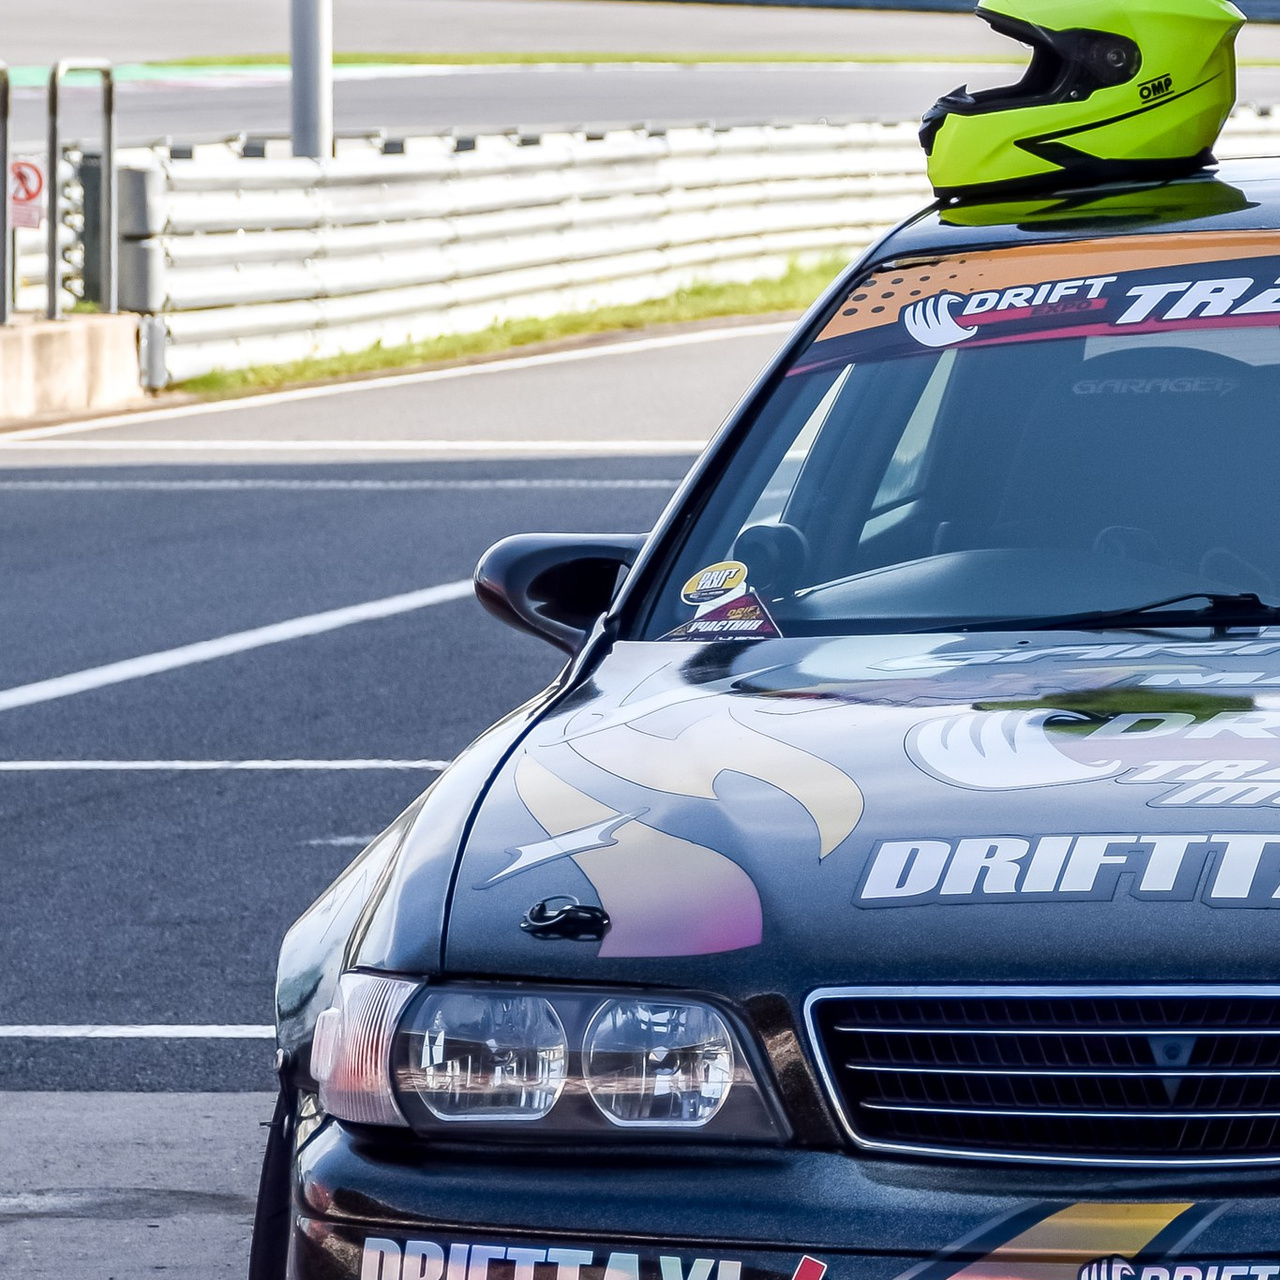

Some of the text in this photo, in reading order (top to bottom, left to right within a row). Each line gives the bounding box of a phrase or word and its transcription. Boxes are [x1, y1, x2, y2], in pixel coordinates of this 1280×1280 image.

[1139, 77, 1173, 99] OMP
[962, 276, 1117, 316] DRIFT
[700, 568, 741, 581] DRIFT
